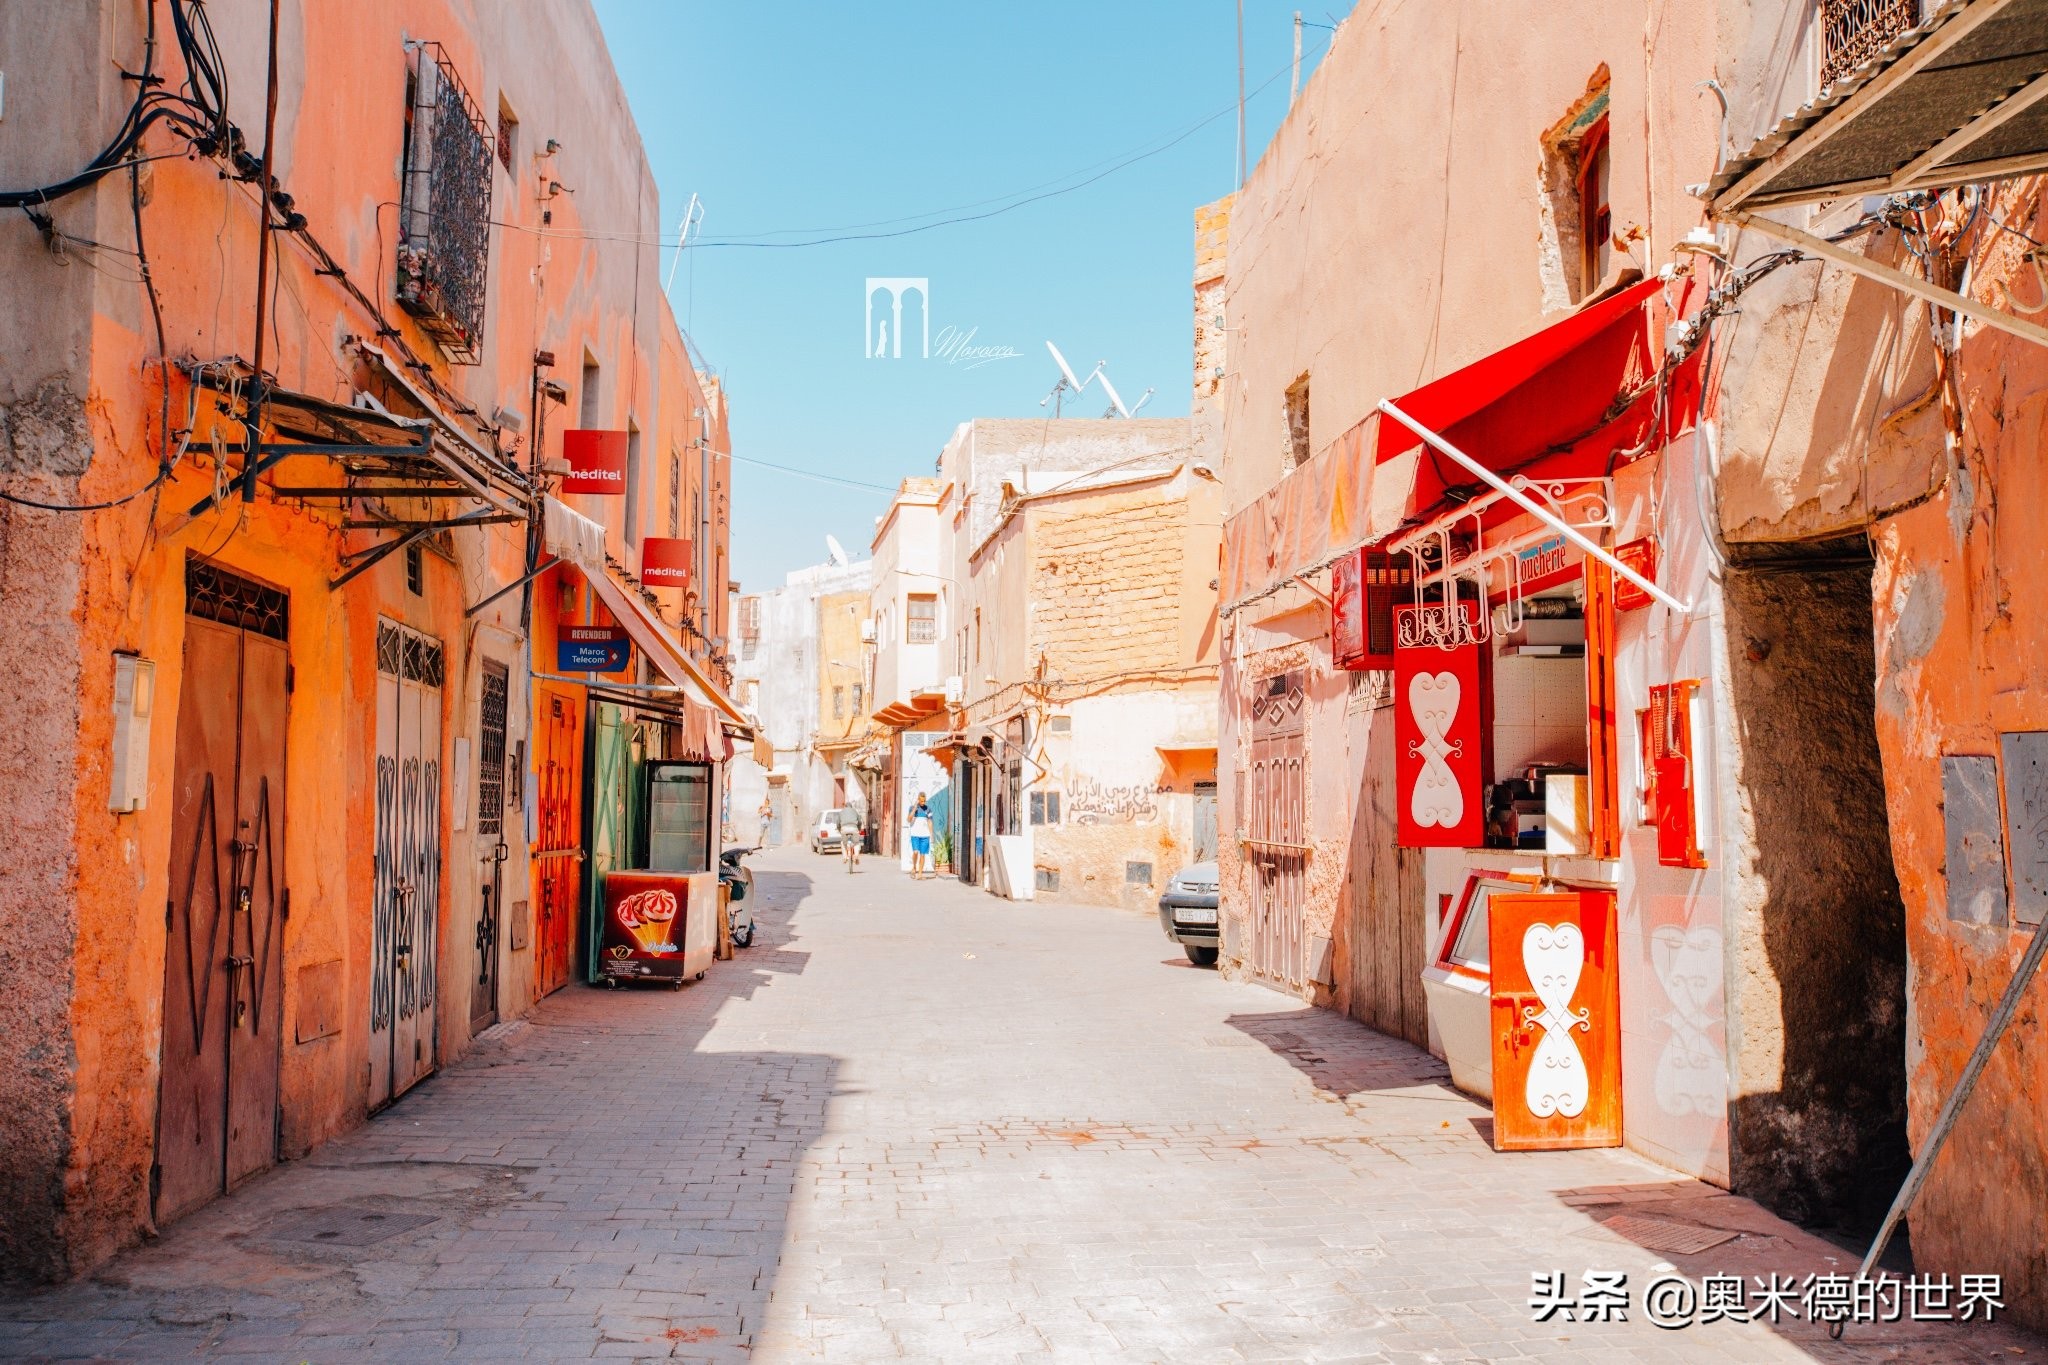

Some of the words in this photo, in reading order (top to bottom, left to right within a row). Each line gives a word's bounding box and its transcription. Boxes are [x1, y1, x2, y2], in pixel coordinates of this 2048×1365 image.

[571, 630, 611, 639] REVENDEUR
[579, 647, 605, 656] Maroc
[571, 655, 605, 664] Telecom
[1132, 783, 1173, 806] ممنوع
